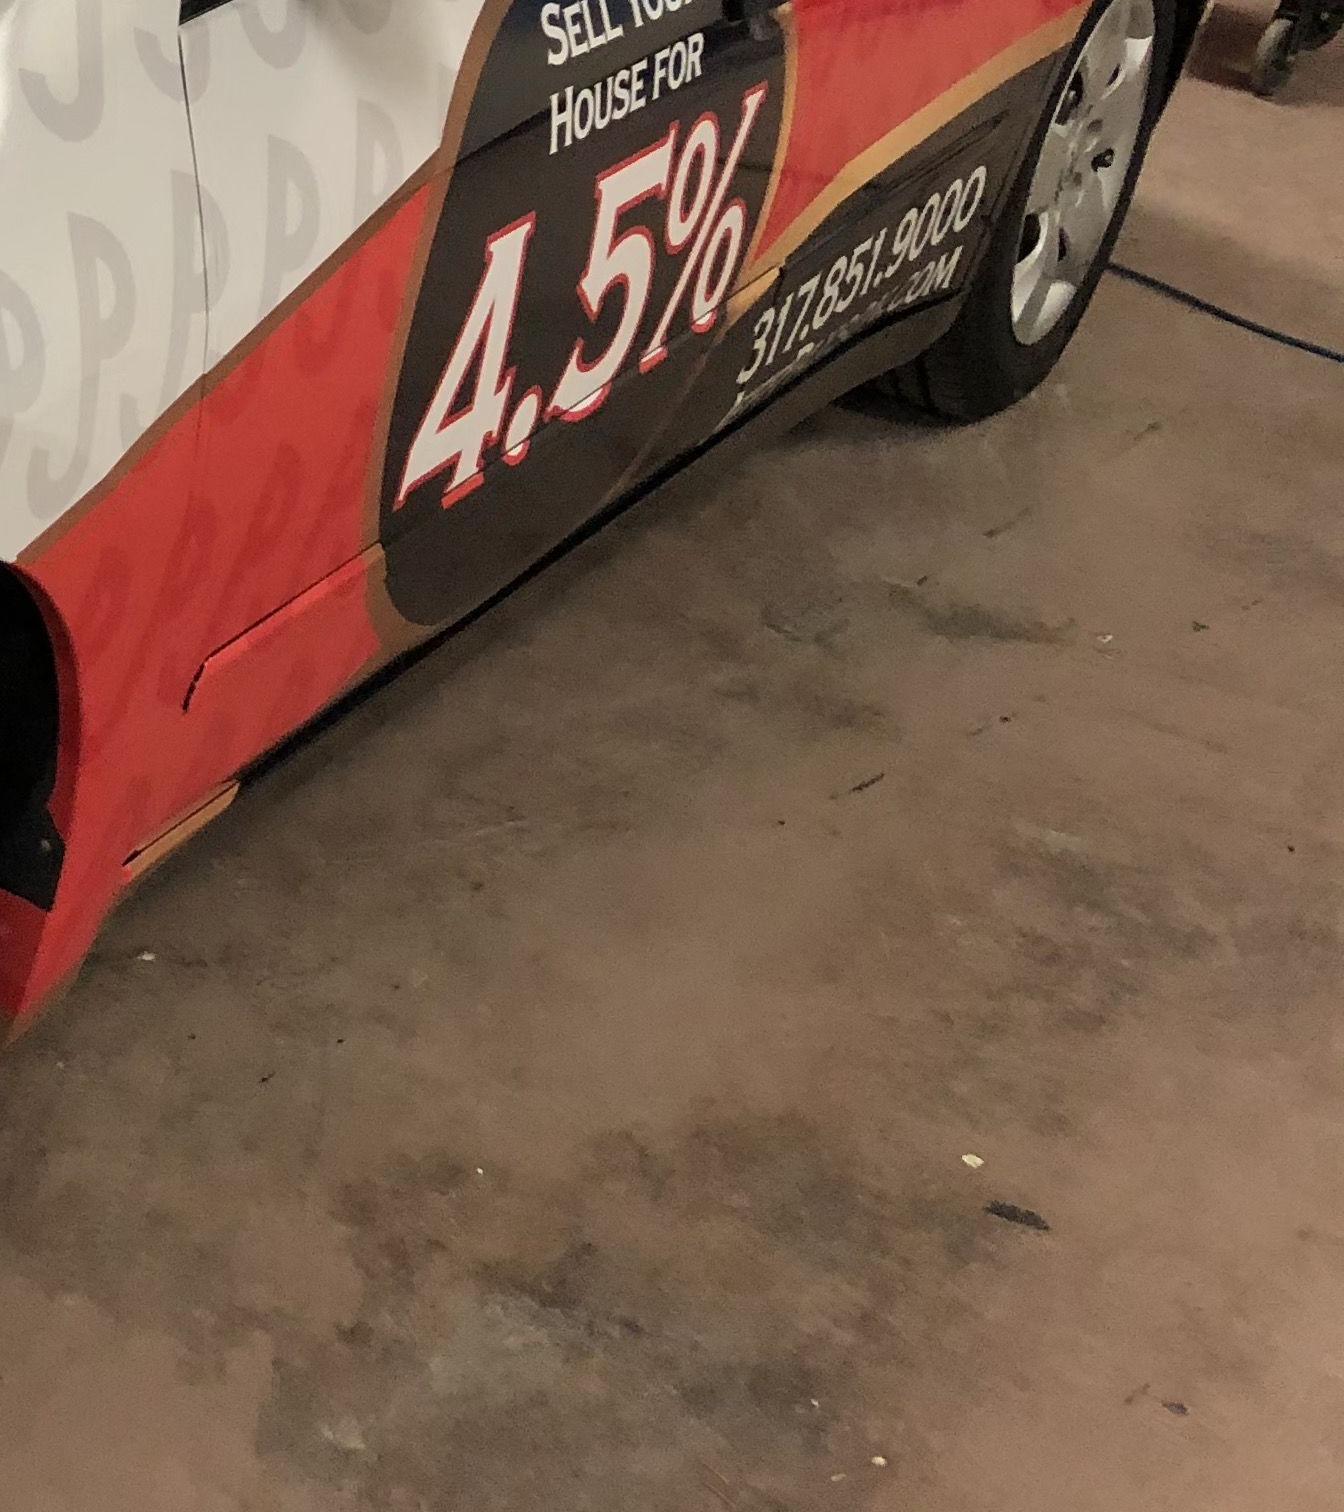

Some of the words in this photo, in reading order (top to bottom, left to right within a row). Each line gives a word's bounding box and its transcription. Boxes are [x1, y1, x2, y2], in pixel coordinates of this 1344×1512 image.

[549, 71, 648, 156] HOUSE
[652, 32, 705, 100] FOR
[395, 82, 769, 509] 4.5%
[736, 165, 988, 385] 317.851.9000
